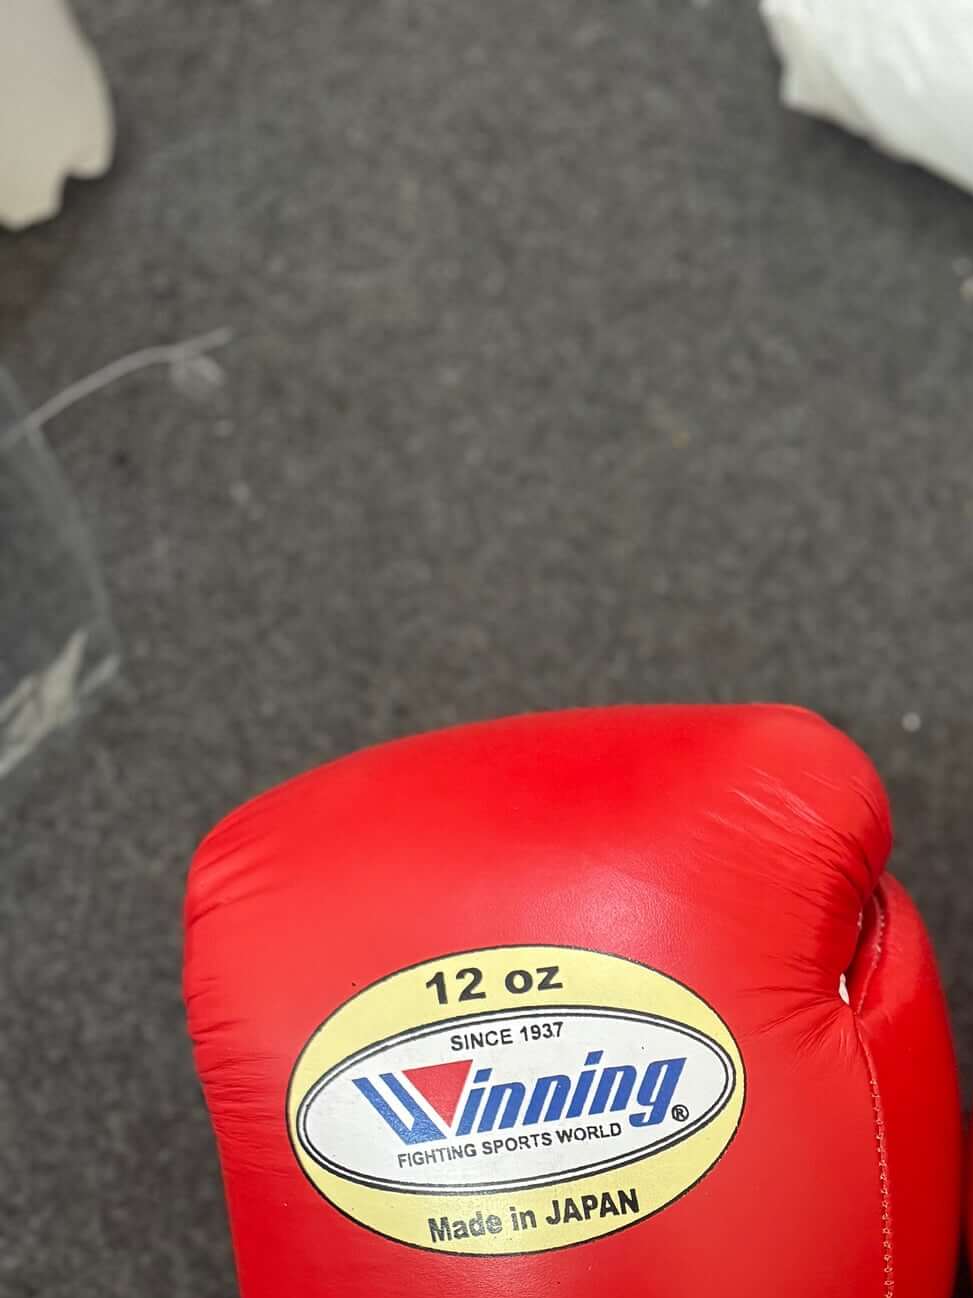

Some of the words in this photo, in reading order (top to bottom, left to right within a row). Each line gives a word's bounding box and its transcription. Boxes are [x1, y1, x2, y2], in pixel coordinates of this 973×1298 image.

[425, 967, 486, 1005] 12
[504, 965, 563, 995] oz
[449, 1028, 513, 1052] SINCE
[519, 1022, 564, 1043] 1937
[351, 1050, 687, 1146] Winning
[397, 1143, 477, 1170] FIGHTING
[481, 1133, 552, 1155] SPORTS
[556, 1122, 622, 1145] WORLD
[427, 1213, 503, 1244] Made
[511, 1206, 537, 1232] in
[546, 1188, 640, 1227] JAPAN
